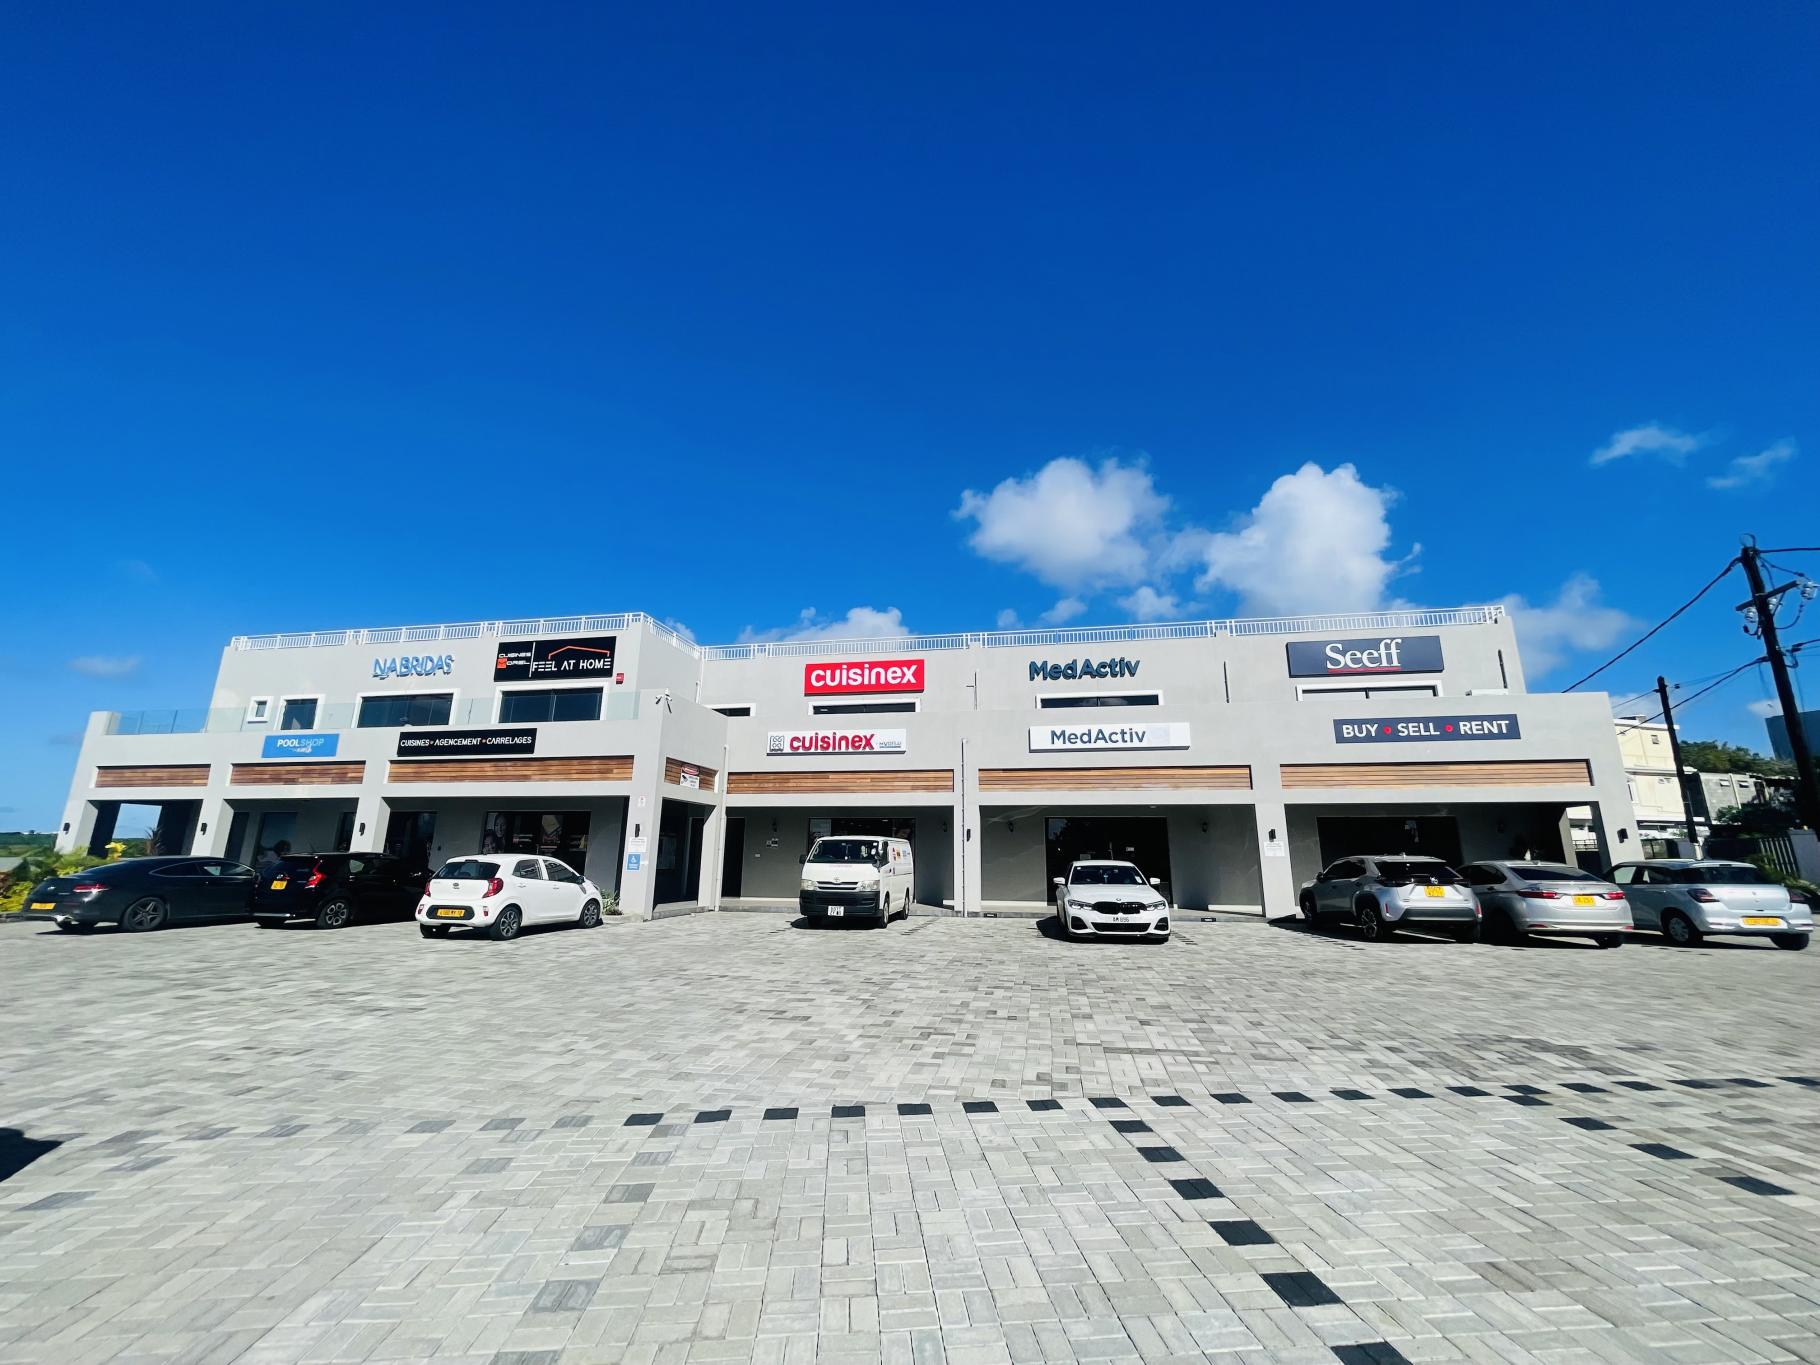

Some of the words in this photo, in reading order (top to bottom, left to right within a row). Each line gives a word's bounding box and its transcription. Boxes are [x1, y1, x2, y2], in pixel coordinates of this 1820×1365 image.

[1325, 639, 1402, 669] Seeff
[373, 655, 453, 677] NABRIDAS
[531, 661, 557, 671] FEEL
[561, 660, 575, 670] AT
[579, 659, 611, 669] HOME
[1029, 657, 1140, 681] MedActiv
[810, 664, 918, 687] cuisinex
[1050, 728, 1146, 745] MedActiv
[1342, 724, 1378, 738] BUY
[1397, 722, 1440, 736] SELL
[1459, 720, 1509, 735] RENT
[400, 739, 430, 747] CUISINES
[434, 737, 481, 746] AGENCEMENT
[486, 736, 532, 745] CARRELAGES
[789, 732, 875, 751] cuisinex
